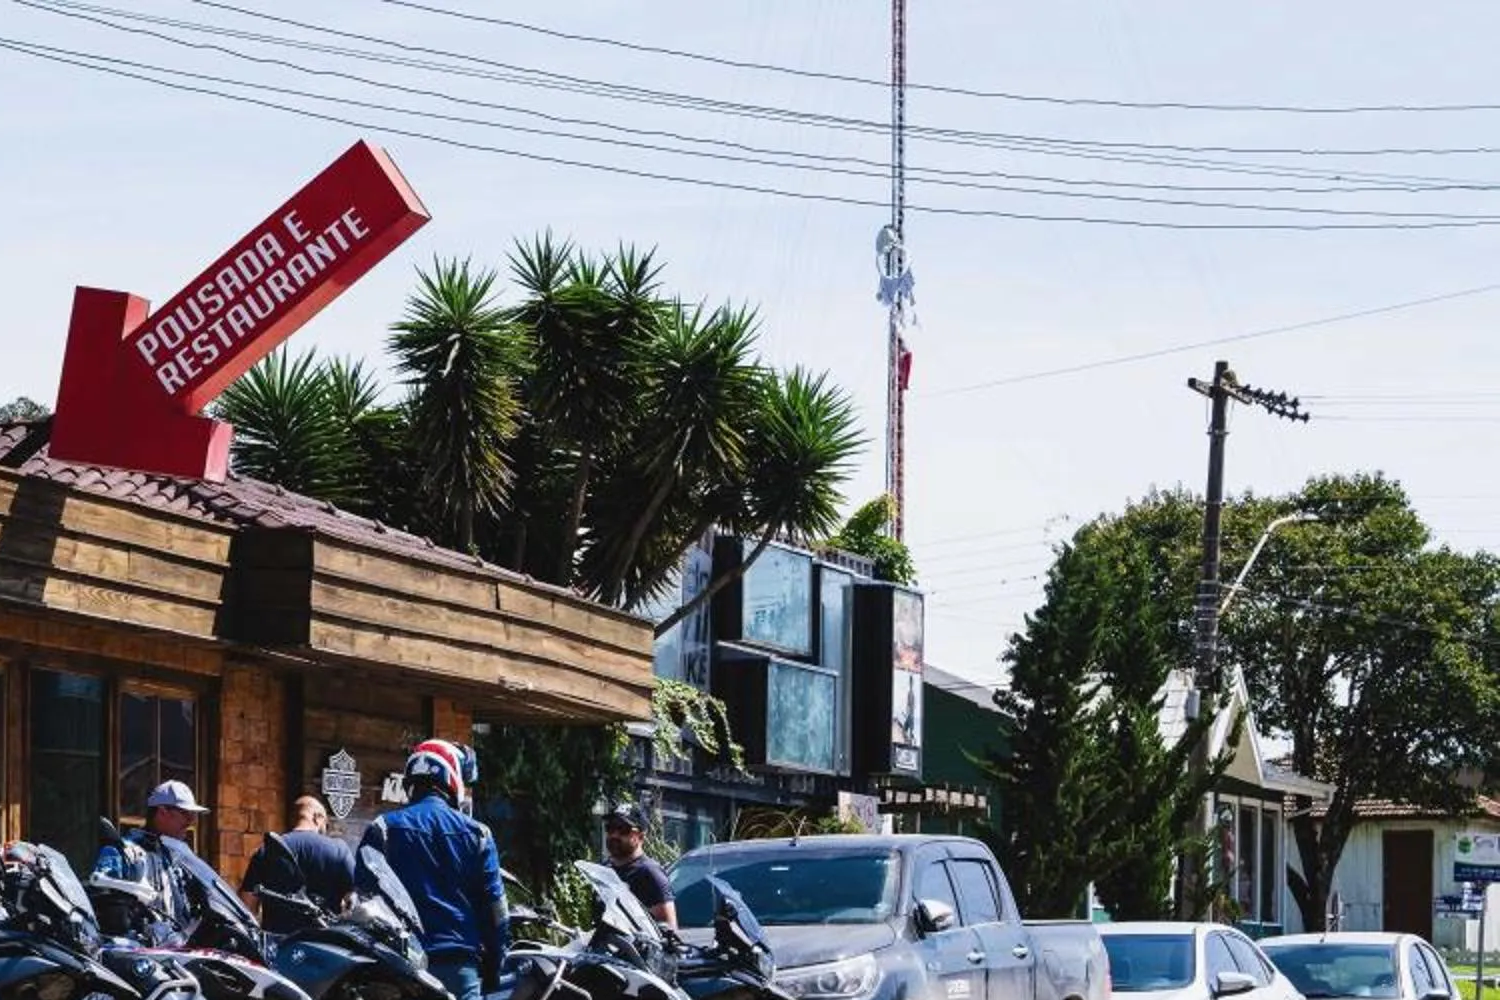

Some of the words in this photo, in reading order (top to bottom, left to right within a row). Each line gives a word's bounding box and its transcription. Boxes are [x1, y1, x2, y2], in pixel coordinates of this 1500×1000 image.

[136, 232, 285, 366] POUSADA
[283, 209, 311, 242] E
[156, 206, 369, 394] RESTAURANTE
